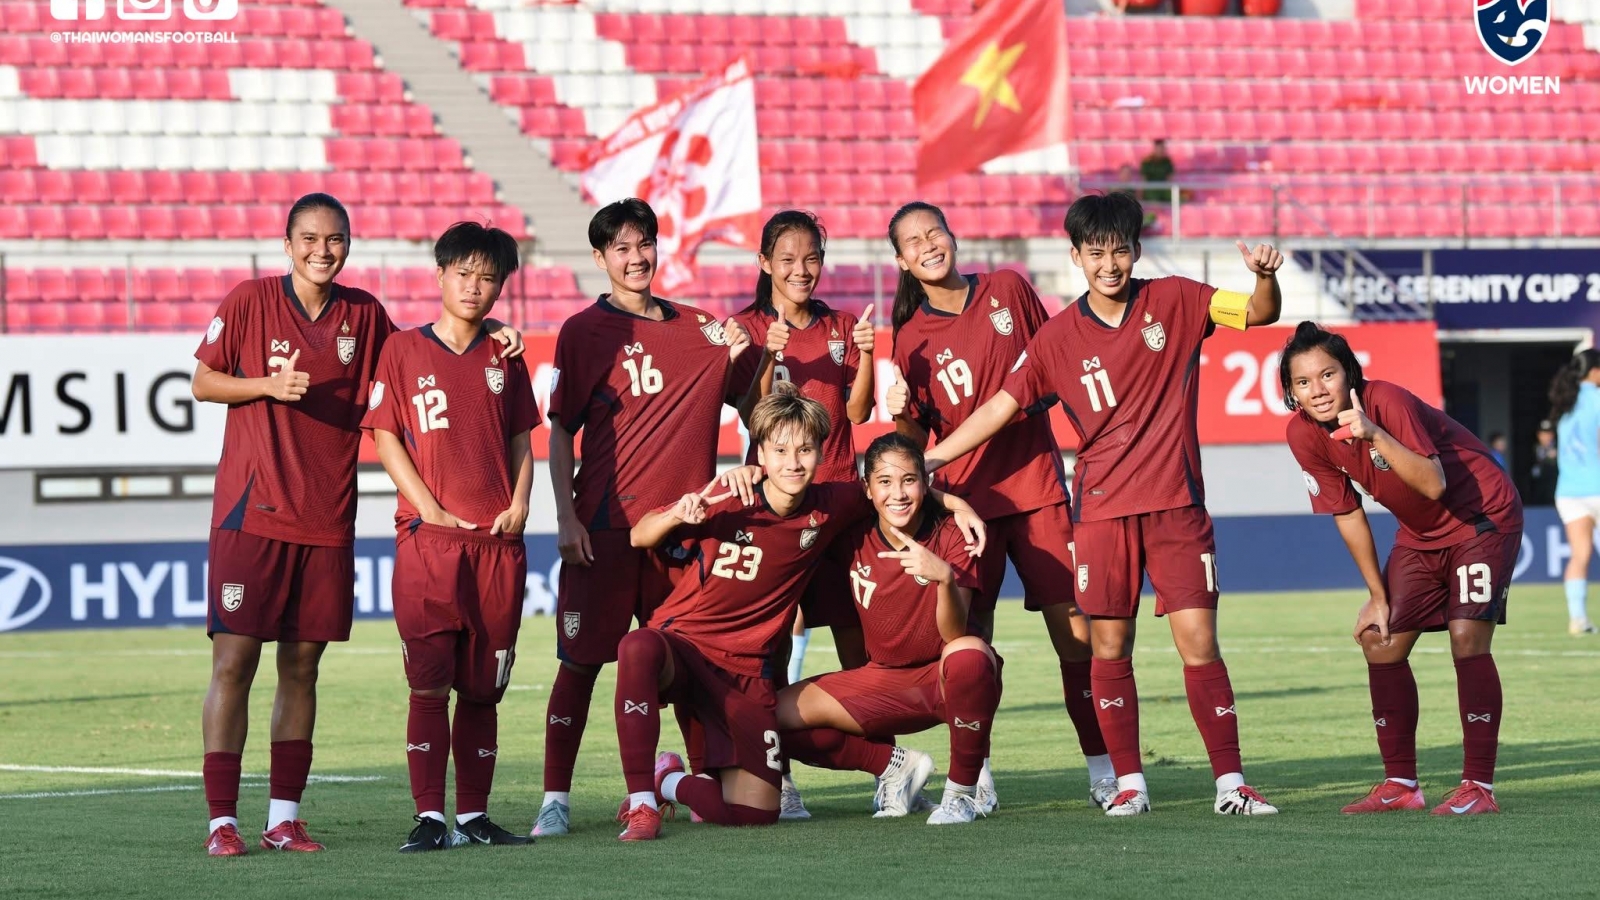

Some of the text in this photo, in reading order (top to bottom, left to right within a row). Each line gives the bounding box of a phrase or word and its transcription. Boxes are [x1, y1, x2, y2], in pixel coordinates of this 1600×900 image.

[1397, 274, 1524, 304] SERENITY
[1525, 272, 1580, 303] CUP
[622, 355, 664, 397] 16
[936, 358, 974, 405] 19
[1080, 368, 1117, 412] 11
[0, 371, 195, 435] MSIG
[412, 389, 450, 434] 12
[711, 541, 763, 581] 23
[1200, 552, 1219, 592] 1
[850, 570, 877, 610] 17
[1456, 562, 1492, 604] 13
